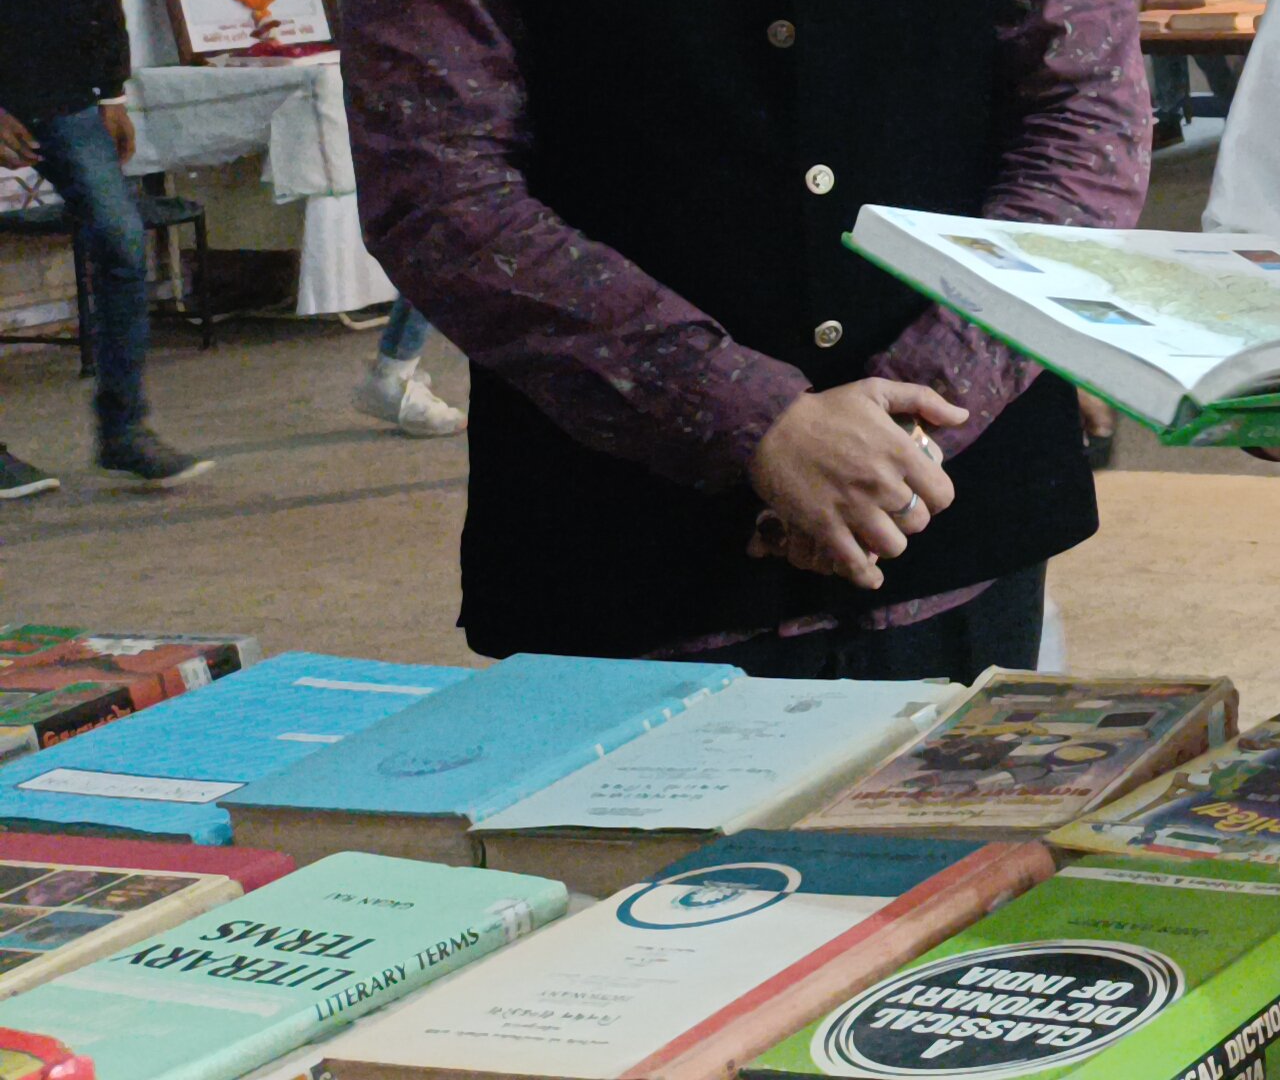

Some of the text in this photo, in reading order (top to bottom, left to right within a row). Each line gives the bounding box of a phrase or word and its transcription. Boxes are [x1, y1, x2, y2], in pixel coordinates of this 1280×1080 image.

[199, 920, 376, 960] TERMS
[109, 943, 357, 992] LITERARY
[315, 926, 480, 1021] LITERARY TERMS
[957, 966, 1134, 1001] OF INDIA
[886, 985, 1138, 1026] DICTIONARY
[870, 1008, 1092, 1047] CLASSICAL
[920, 1038, 964, 1059] A
